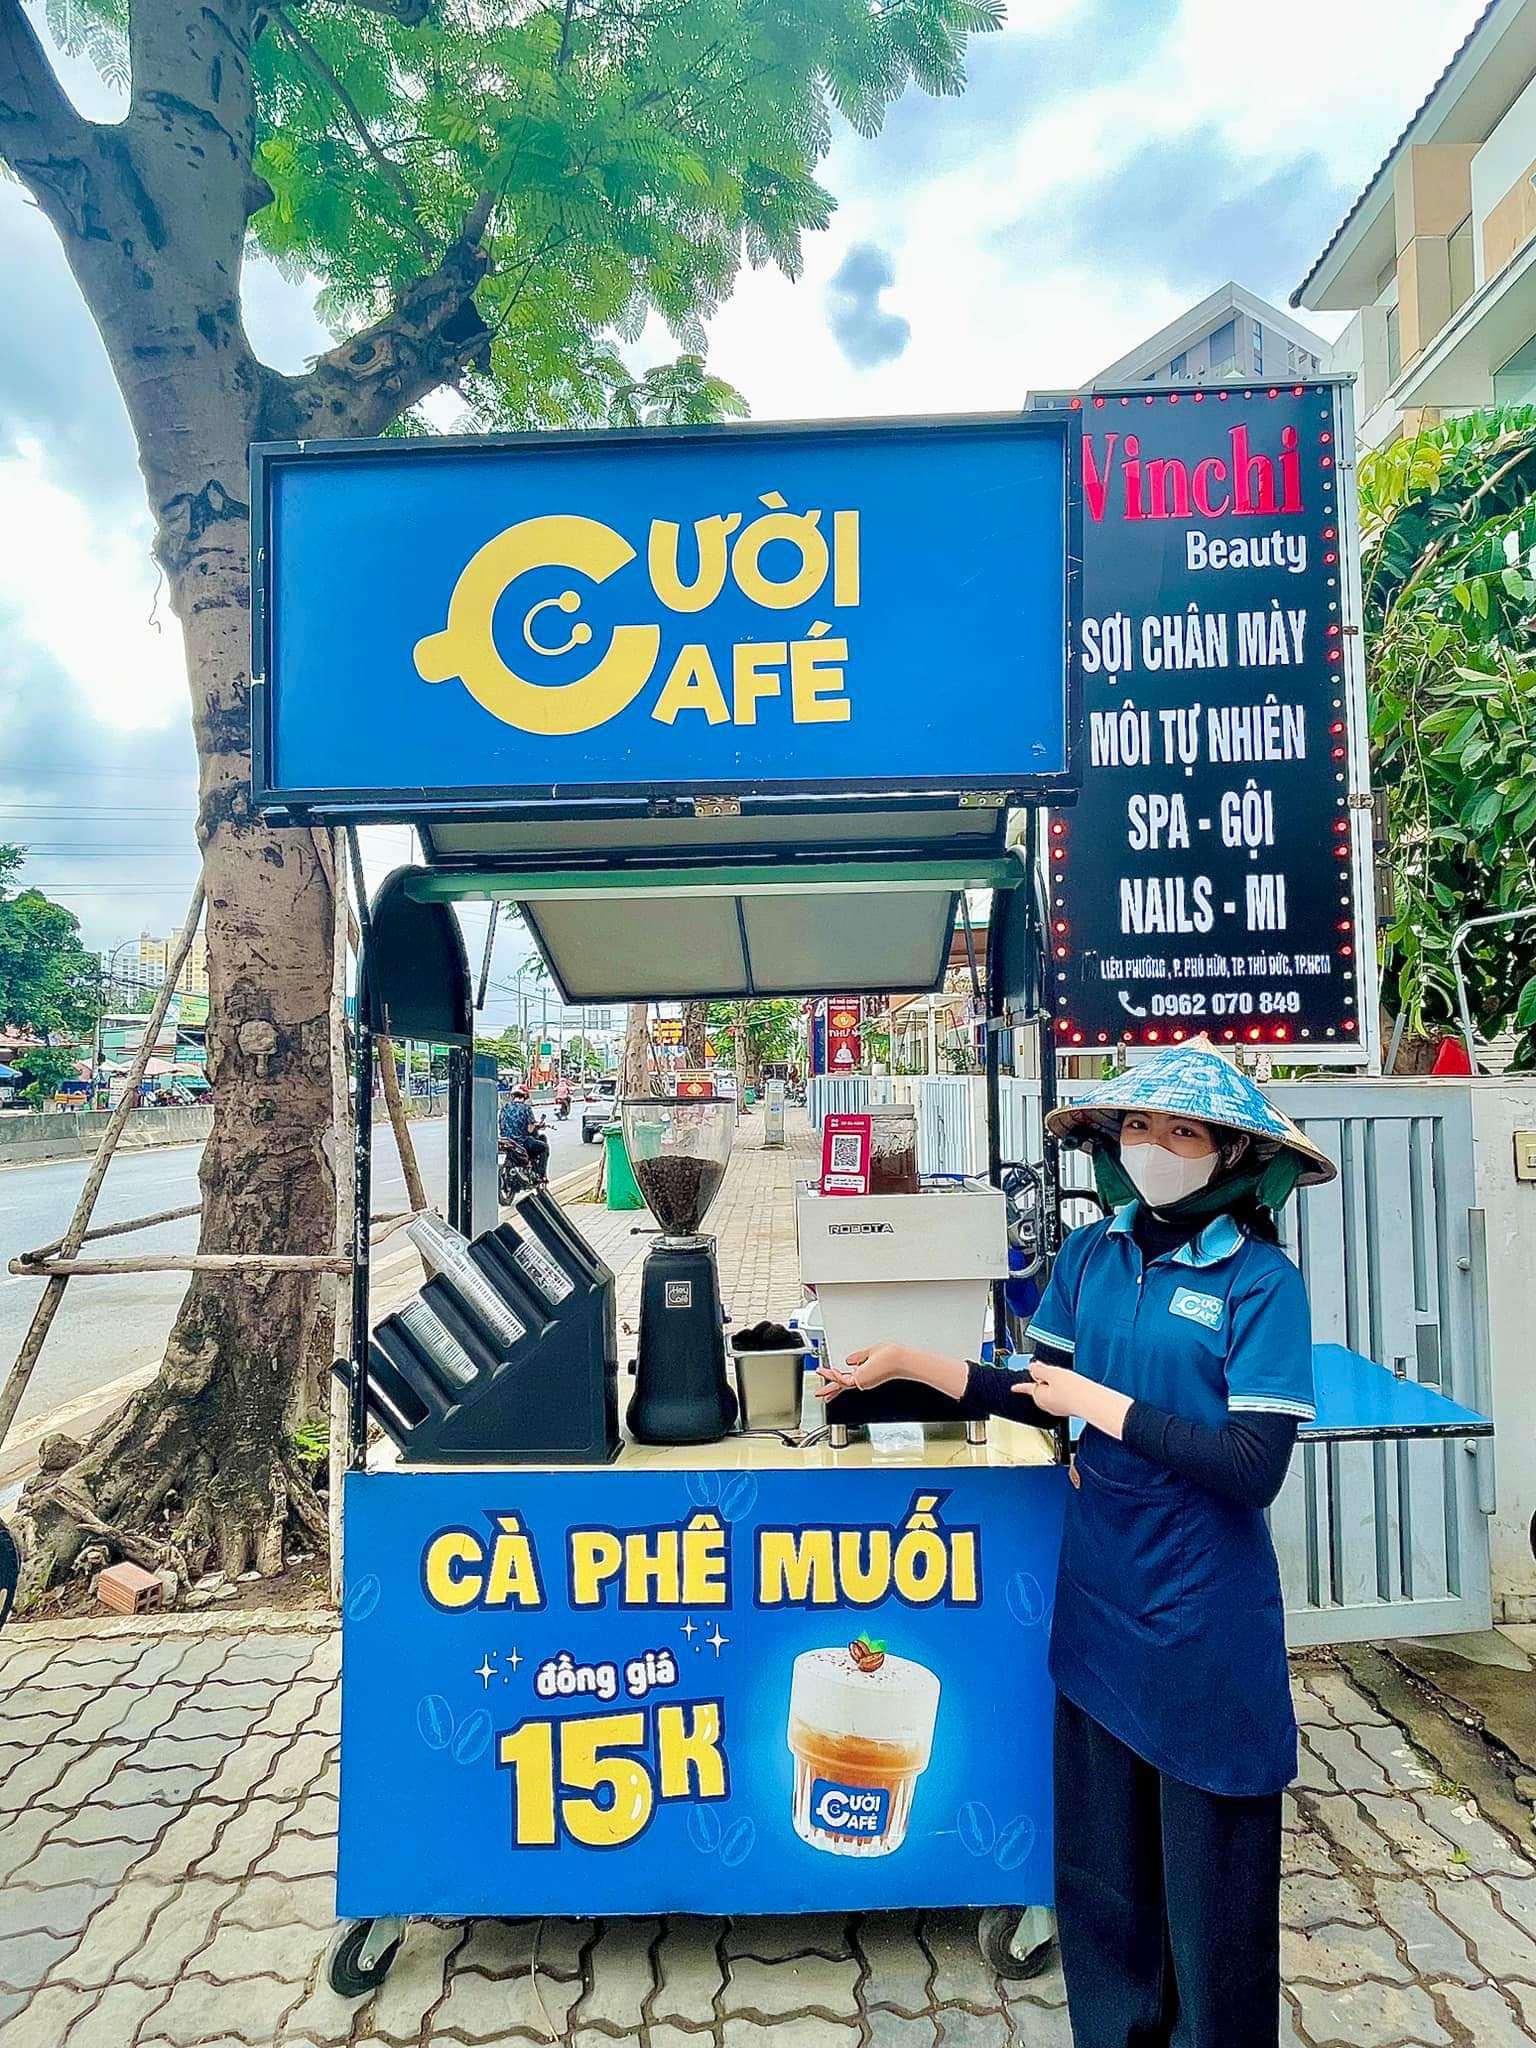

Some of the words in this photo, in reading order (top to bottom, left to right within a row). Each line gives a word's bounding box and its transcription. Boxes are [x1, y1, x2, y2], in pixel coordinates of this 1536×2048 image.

[1083, 424, 1305, 521] Vinchi
[1186, 530, 1307, 574] Beauty
[1082, 609, 1132, 684] SỢI
[1142, 602, 1228, 670] CHÂN
[1238, 599, 1307, 667] MÀY
[1090, 699, 1150, 767] MÔI
[1159, 703, 1203, 776] TỰ
[1208, 694, 1307, 763] NHIÊN
[1128, 792, 1190, 850] SPA
[1221, 780, 1274, 860] GỘI
[1121, 877, 1215, 935] NAILS
[1247, 875, 1287, 931] MI
[1151, 993, 1207, 1016] 0962
[1212, 992, 1253, 1015] 070
[1259, 991, 1301, 1014] 849
[829, 1223, 895, 1234] ROBOTA
[424, 1517, 541, 1606] CÀ
[571, 1511, 727, 1605] PHÊ
[757, 1495, 979, 1605] MUỐI
[536, 1652, 617, 1698] đồng
[626, 1653, 678, 1697] giá
[499, 1703, 727, 1847] 15K
